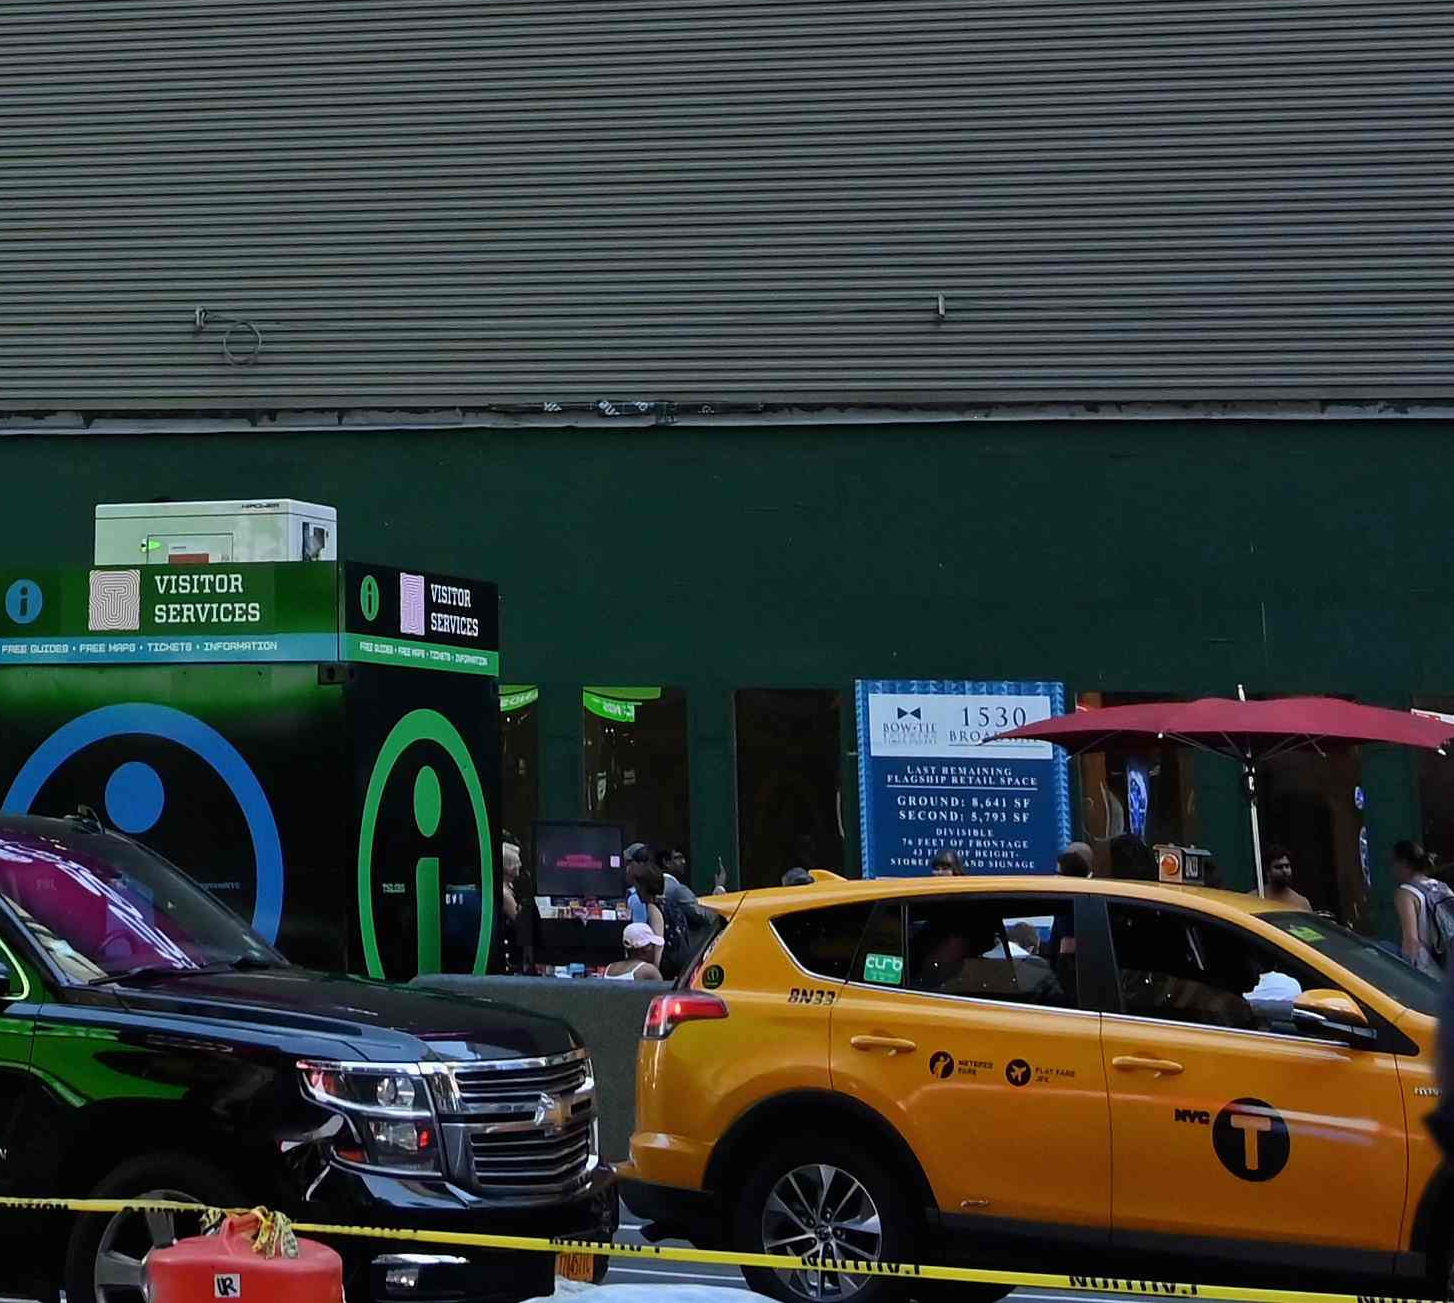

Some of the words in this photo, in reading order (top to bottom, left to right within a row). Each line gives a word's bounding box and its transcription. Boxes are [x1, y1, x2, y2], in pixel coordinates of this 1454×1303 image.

[154, 574, 244, 594] VISITOR
[430, 583, 472, 608] VISITOR
[154, 602, 260, 623] SERVICES
[430, 611, 479, 637] SERVICES
[1, 644, 28, 654] FREE
[30, 643, 69, 654] GUIDES
[79, 643, 107, 653] FREE
[108, 642, 136, 653] MAPS
[147, 642, 193, 652] TICKETS
[203, 641, 278, 652] INFORMATION
[961, 706, 1027, 728] 1530
[906, 765, 936, 775] LAST
[941, 766, 1012, 776] REMAINING
[887, 774, 948, 785] FLAGSHIP
[951, 775, 995, 785] RETAIL
[1000, 776, 1038, 786] SPACE
[897, 795, 965, 807] GROUND:
[971, 797, 1007, 809] 8,641
[1014, 798, 1031, 809] SF
[899, 809, 965, 821] SECOND:
[971, 811, 1007, 823] 5,793
[1013, 812, 1031, 823] SF
[936, 828, 994, 837] DIVISIBLE
[918, 838, 945, 846] FEET
[950, 839, 965, 847] OF
[969, 839, 1029, 849] FRONTAGE
[963, 859, 984, 868] AND
[989, 860, 1035, 869] SIGNAGE
[866, 953, 903, 971] curb
[1035, 1066, 1053, 1075] FLAT
[1174, 1108, 1210, 1125] NYC
[1230, 1114, 1272, 1170] T
